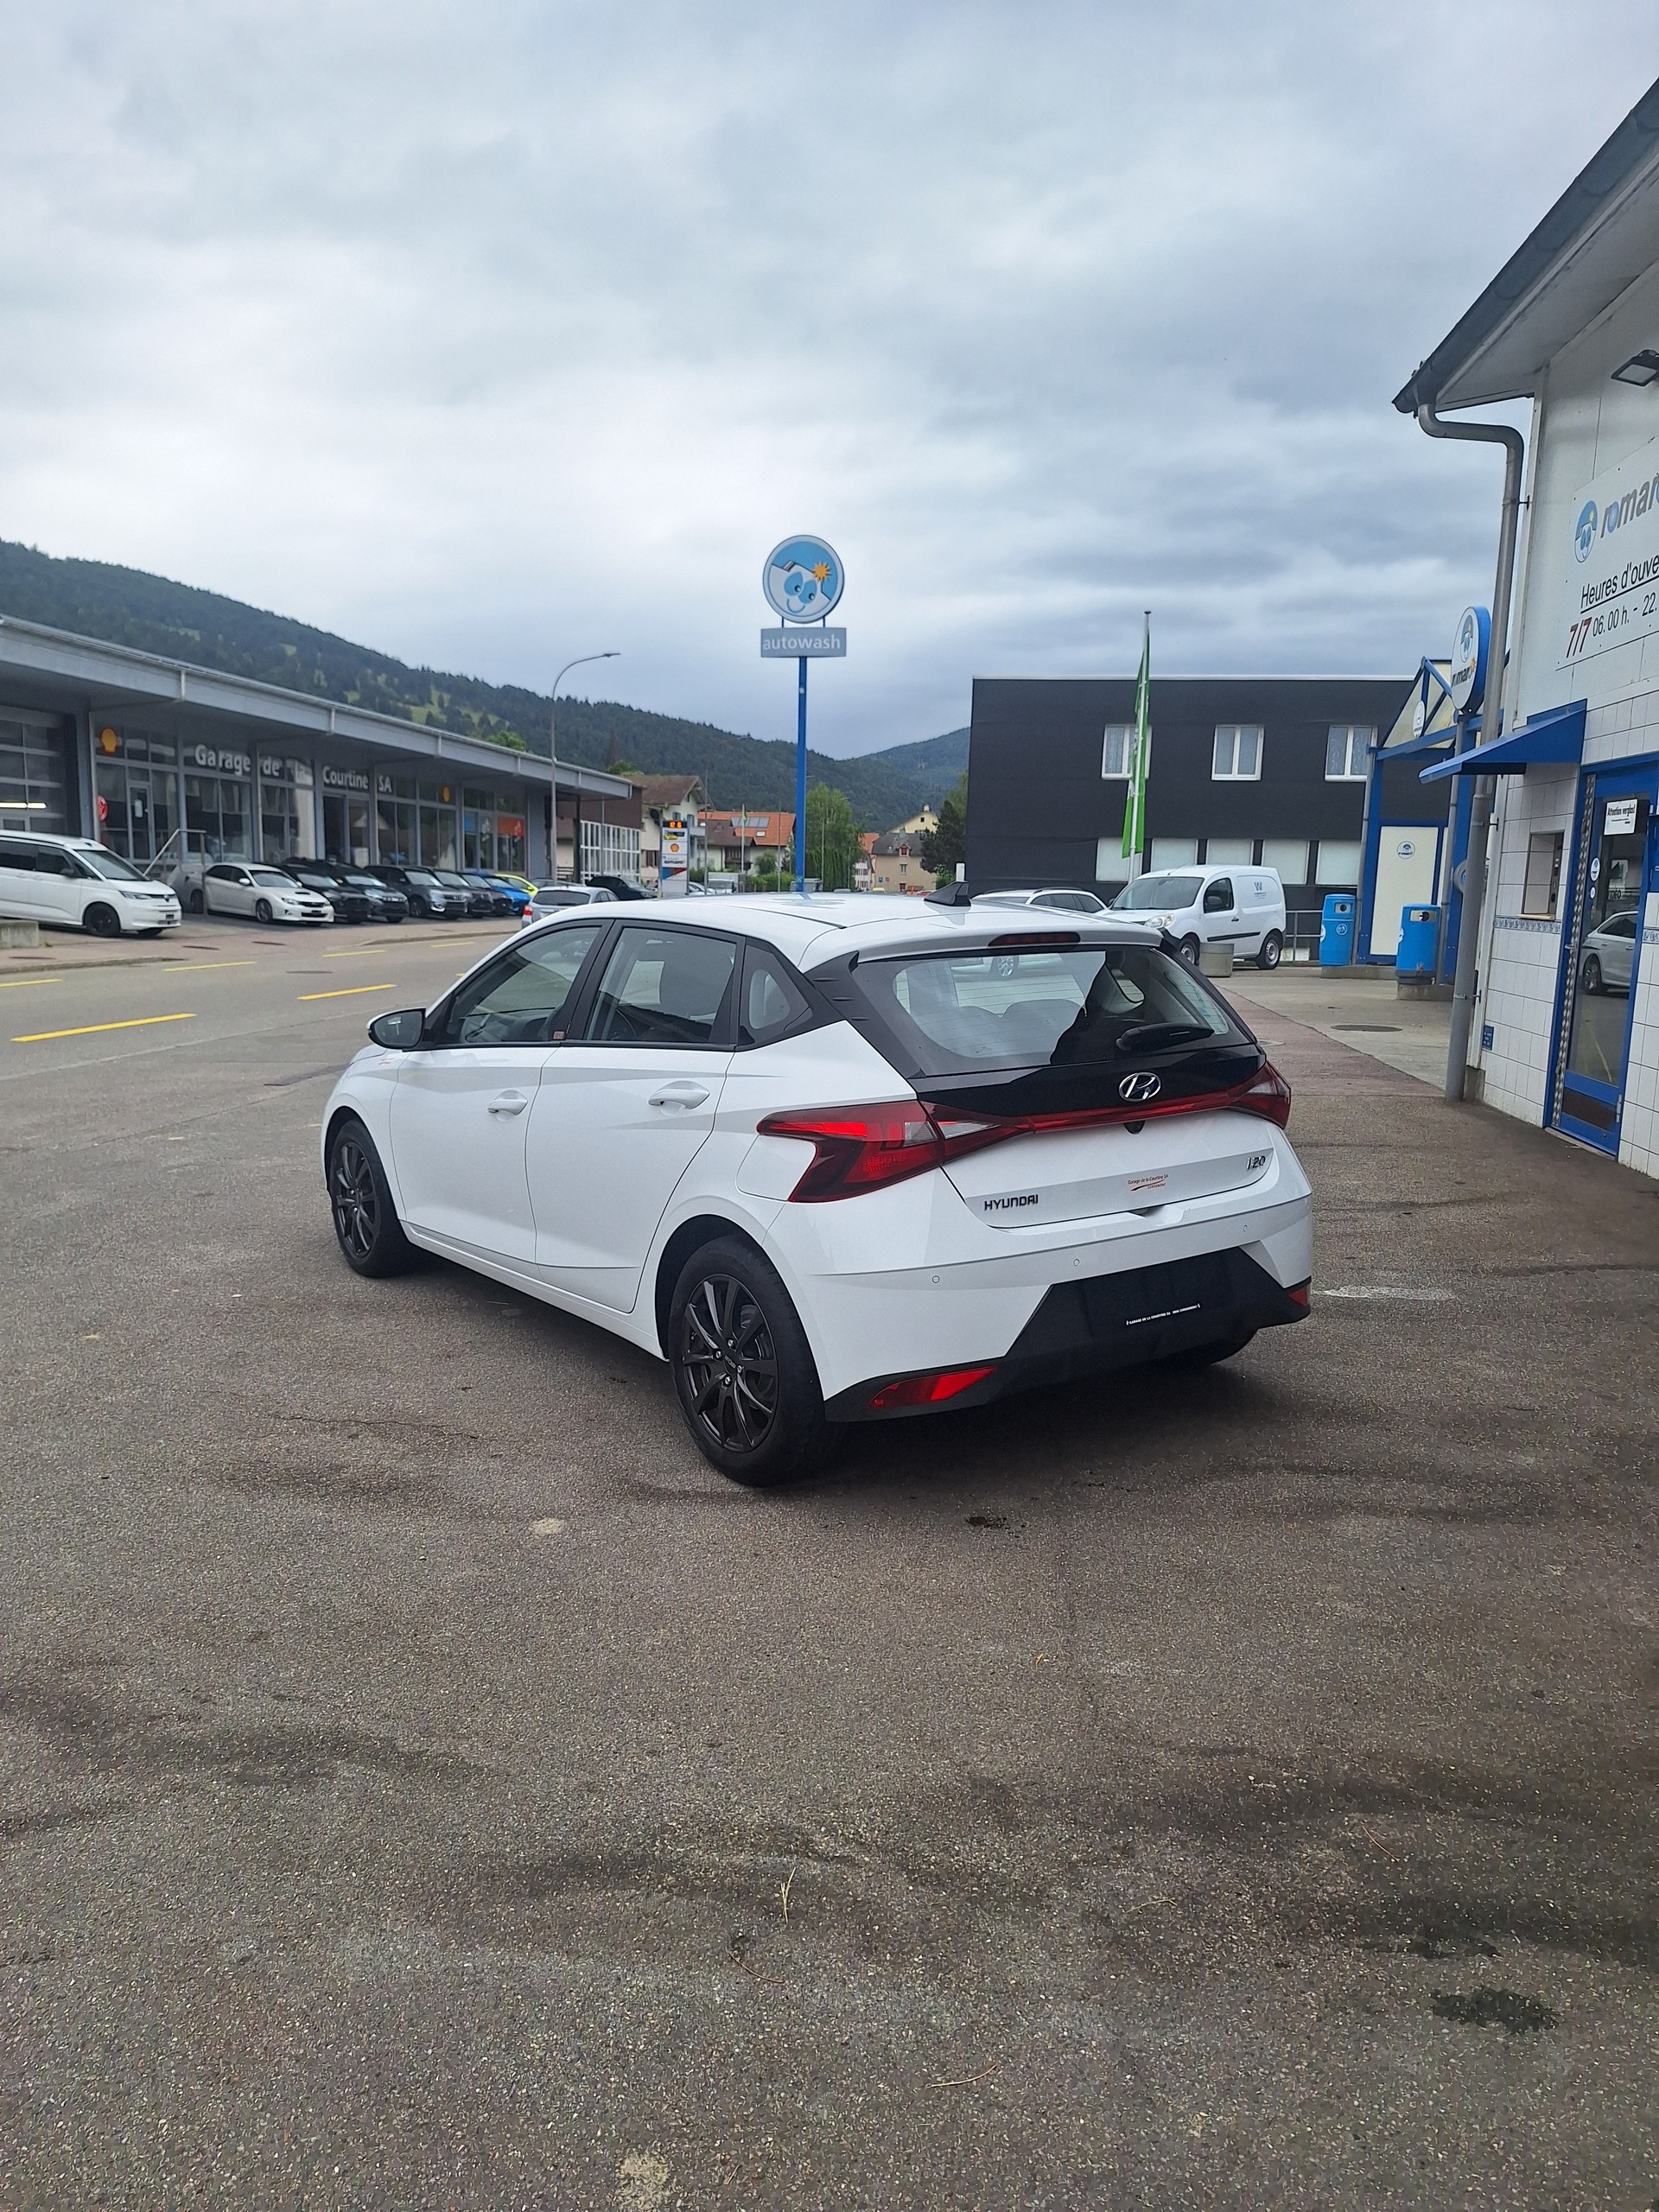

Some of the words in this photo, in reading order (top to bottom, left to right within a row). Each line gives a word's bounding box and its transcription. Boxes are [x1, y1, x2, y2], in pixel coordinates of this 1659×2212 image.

[1600, 475, 1659, 538] romar
[1580, 575, 1618, 609] Heures
[763, 634, 841, 650] autowash
[1566, 617, 1592, 658] 7/7
[194, 744, 251, 776] Garage
[263, 756, 280, 776] de
[322, 766, 369, 790] Courtine
[378, 774, 391, 793] SA
[984, 1193, 1039, 1211] HYUNDAI
